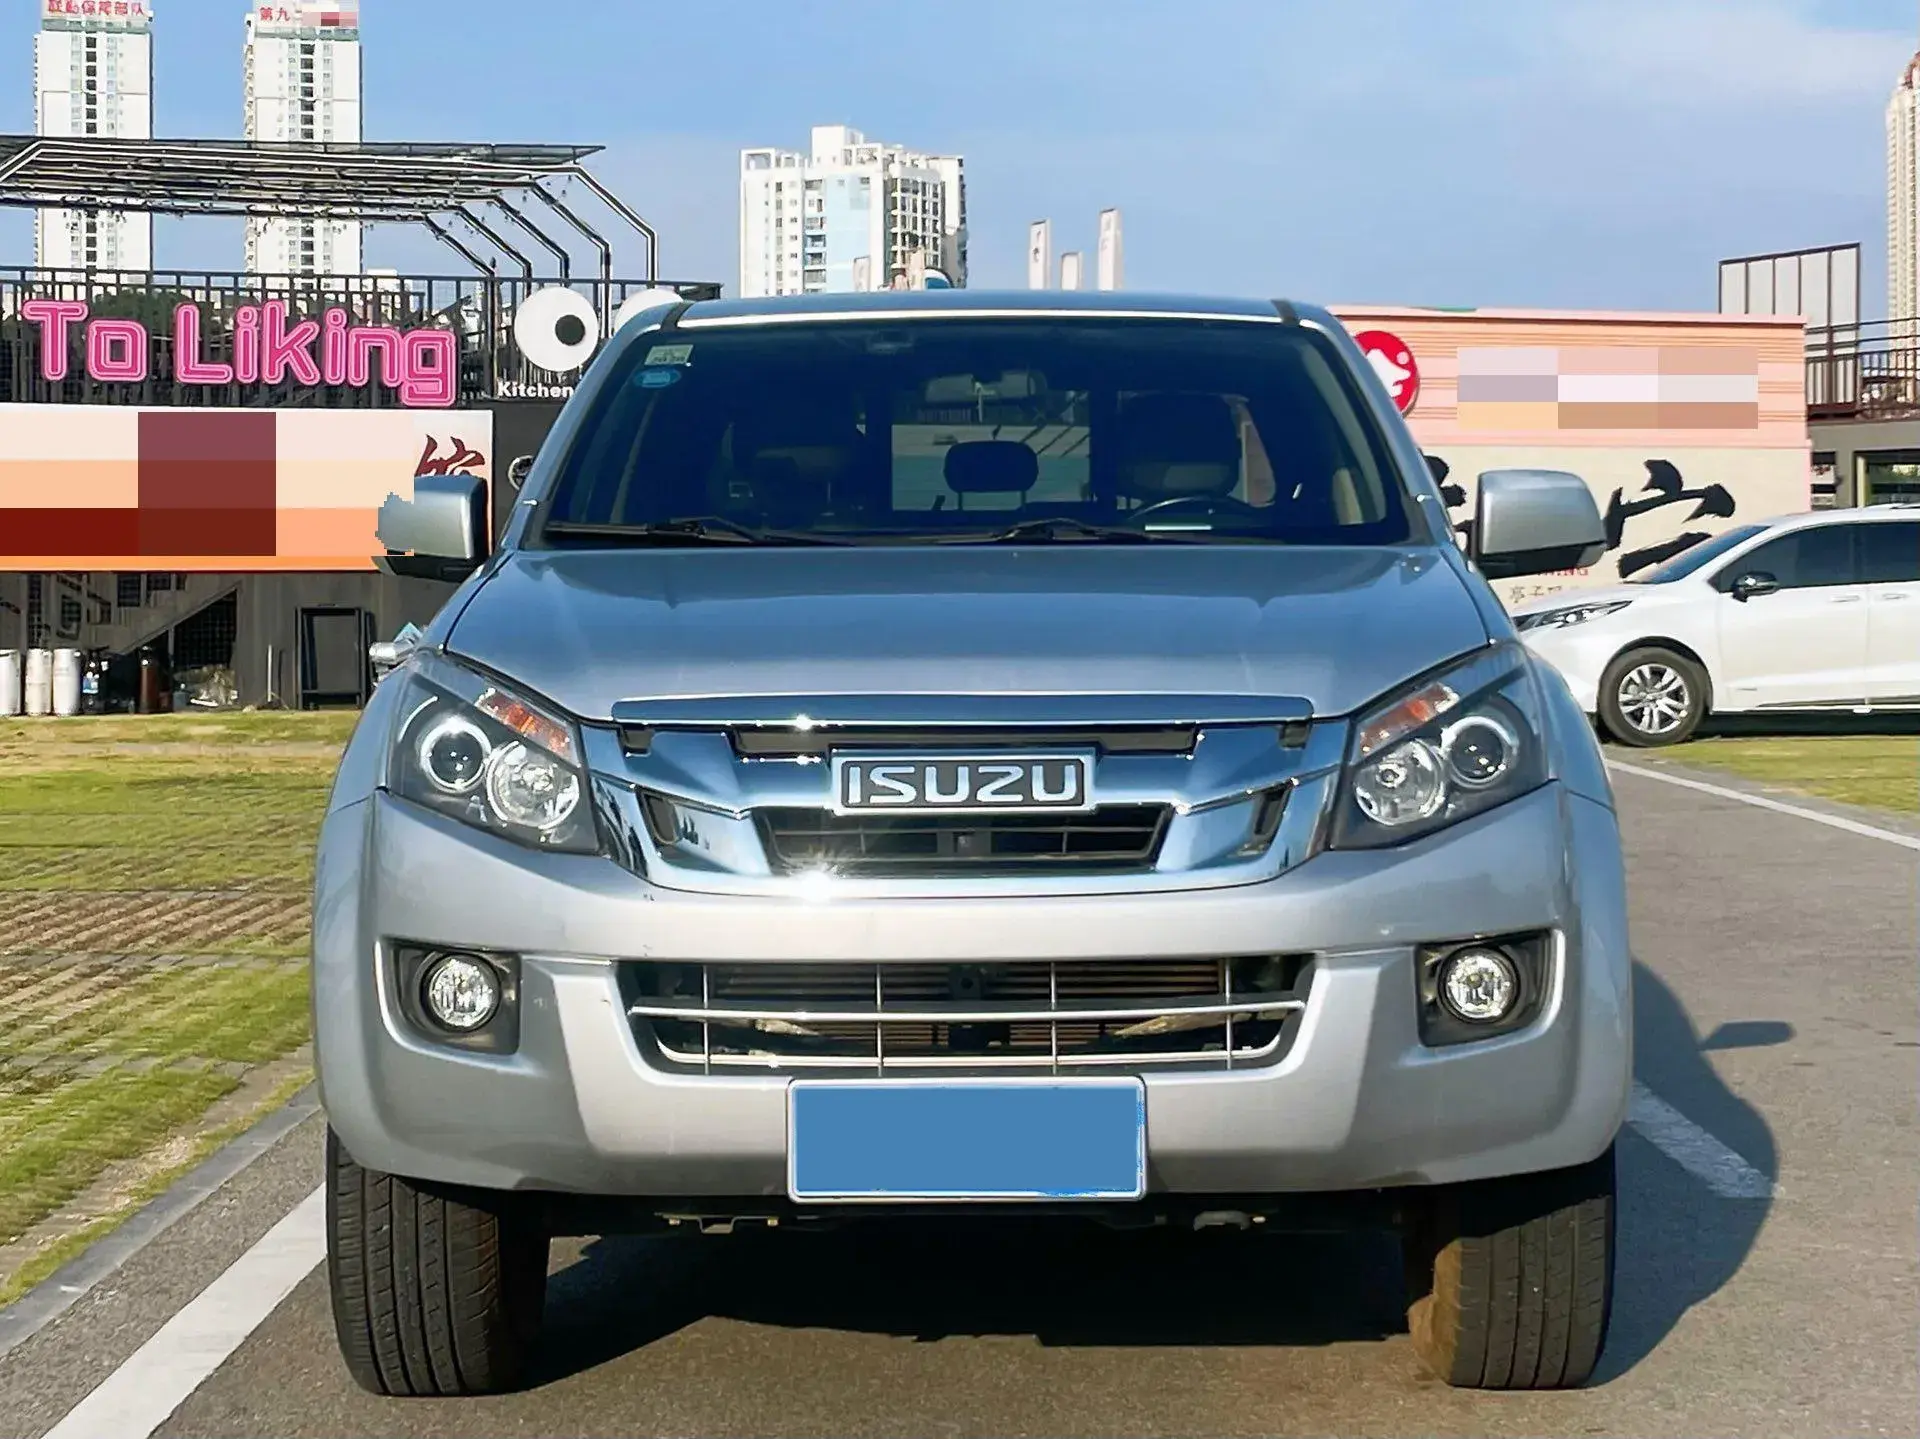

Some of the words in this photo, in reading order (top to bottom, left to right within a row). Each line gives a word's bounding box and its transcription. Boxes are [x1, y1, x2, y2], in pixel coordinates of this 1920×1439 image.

[24, 300, 148, 382] To
[174, 300, 457, 408] Liking
[497, 380, 575, 398] Kitchen
[847, 764, 1077, 804] ISUZU
